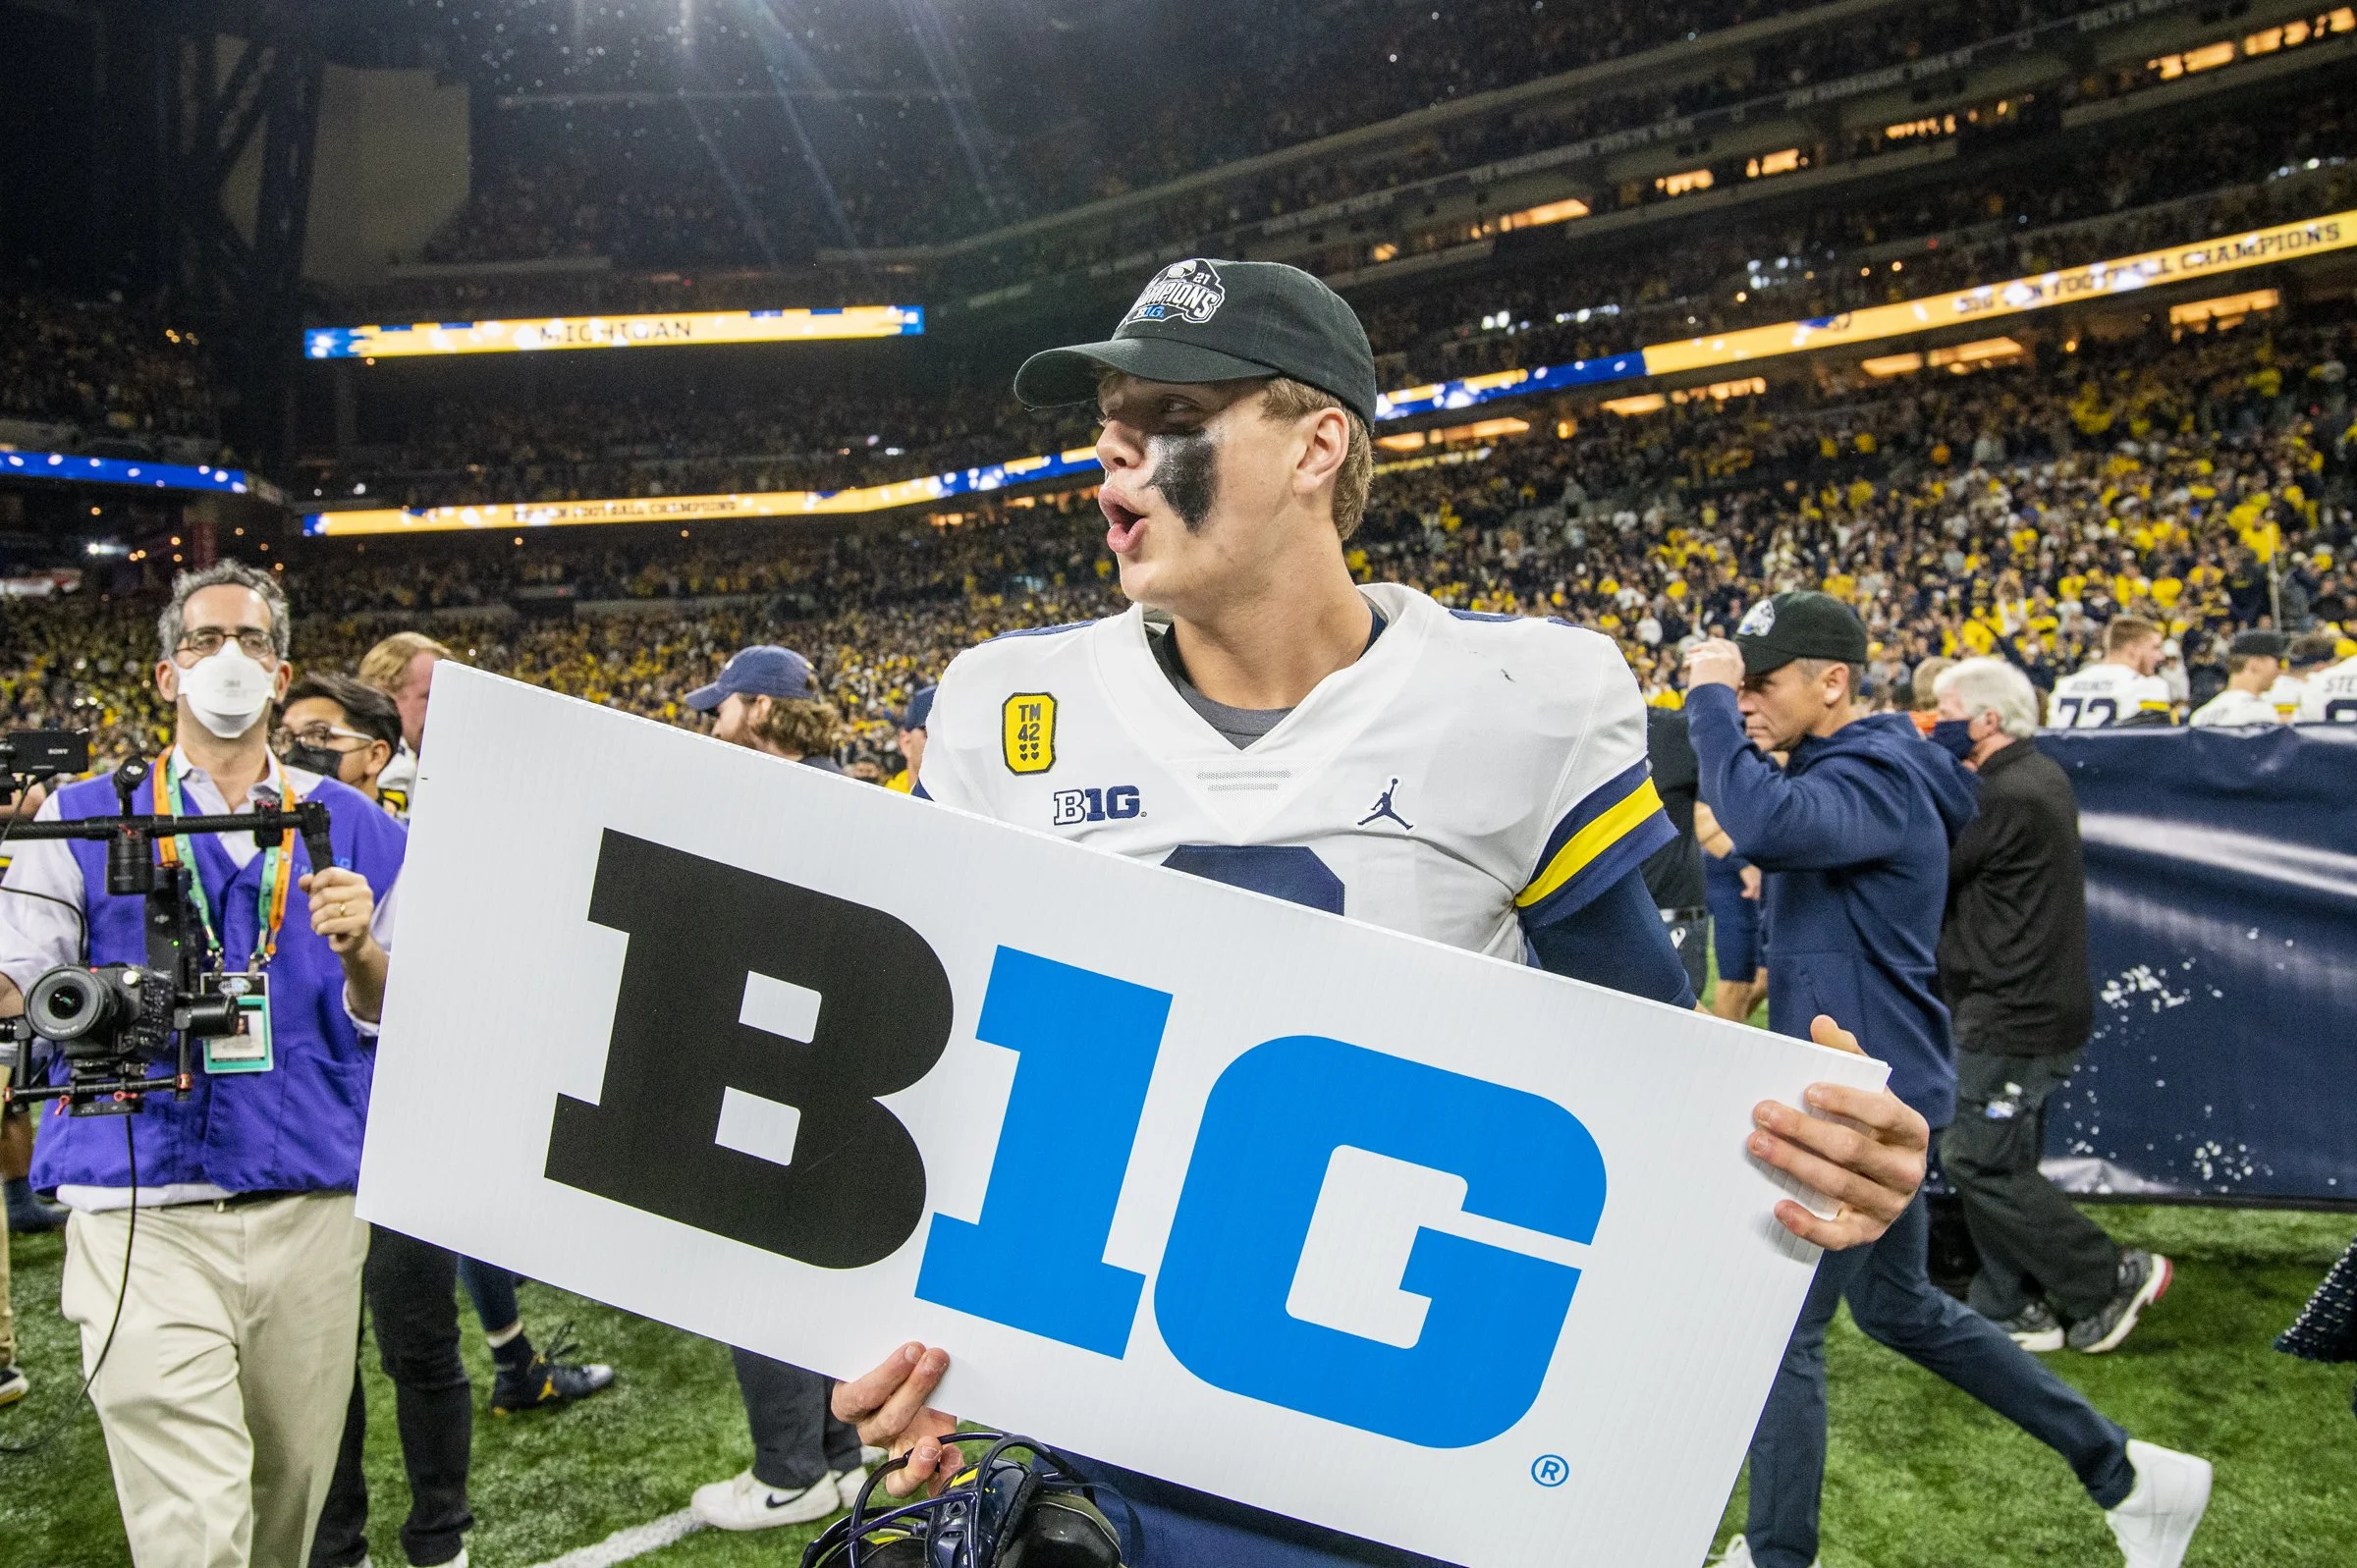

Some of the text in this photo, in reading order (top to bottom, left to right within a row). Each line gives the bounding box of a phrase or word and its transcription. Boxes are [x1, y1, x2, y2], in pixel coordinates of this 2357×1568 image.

[1192, 272, 1211, 285] 21
[1133, 278, 1219, 319] AMPIONS
[1017, 703, 1041, 723] TM
[2058, 698, 2117, 729] 72
[1017, 724, 1040, 742] 42
